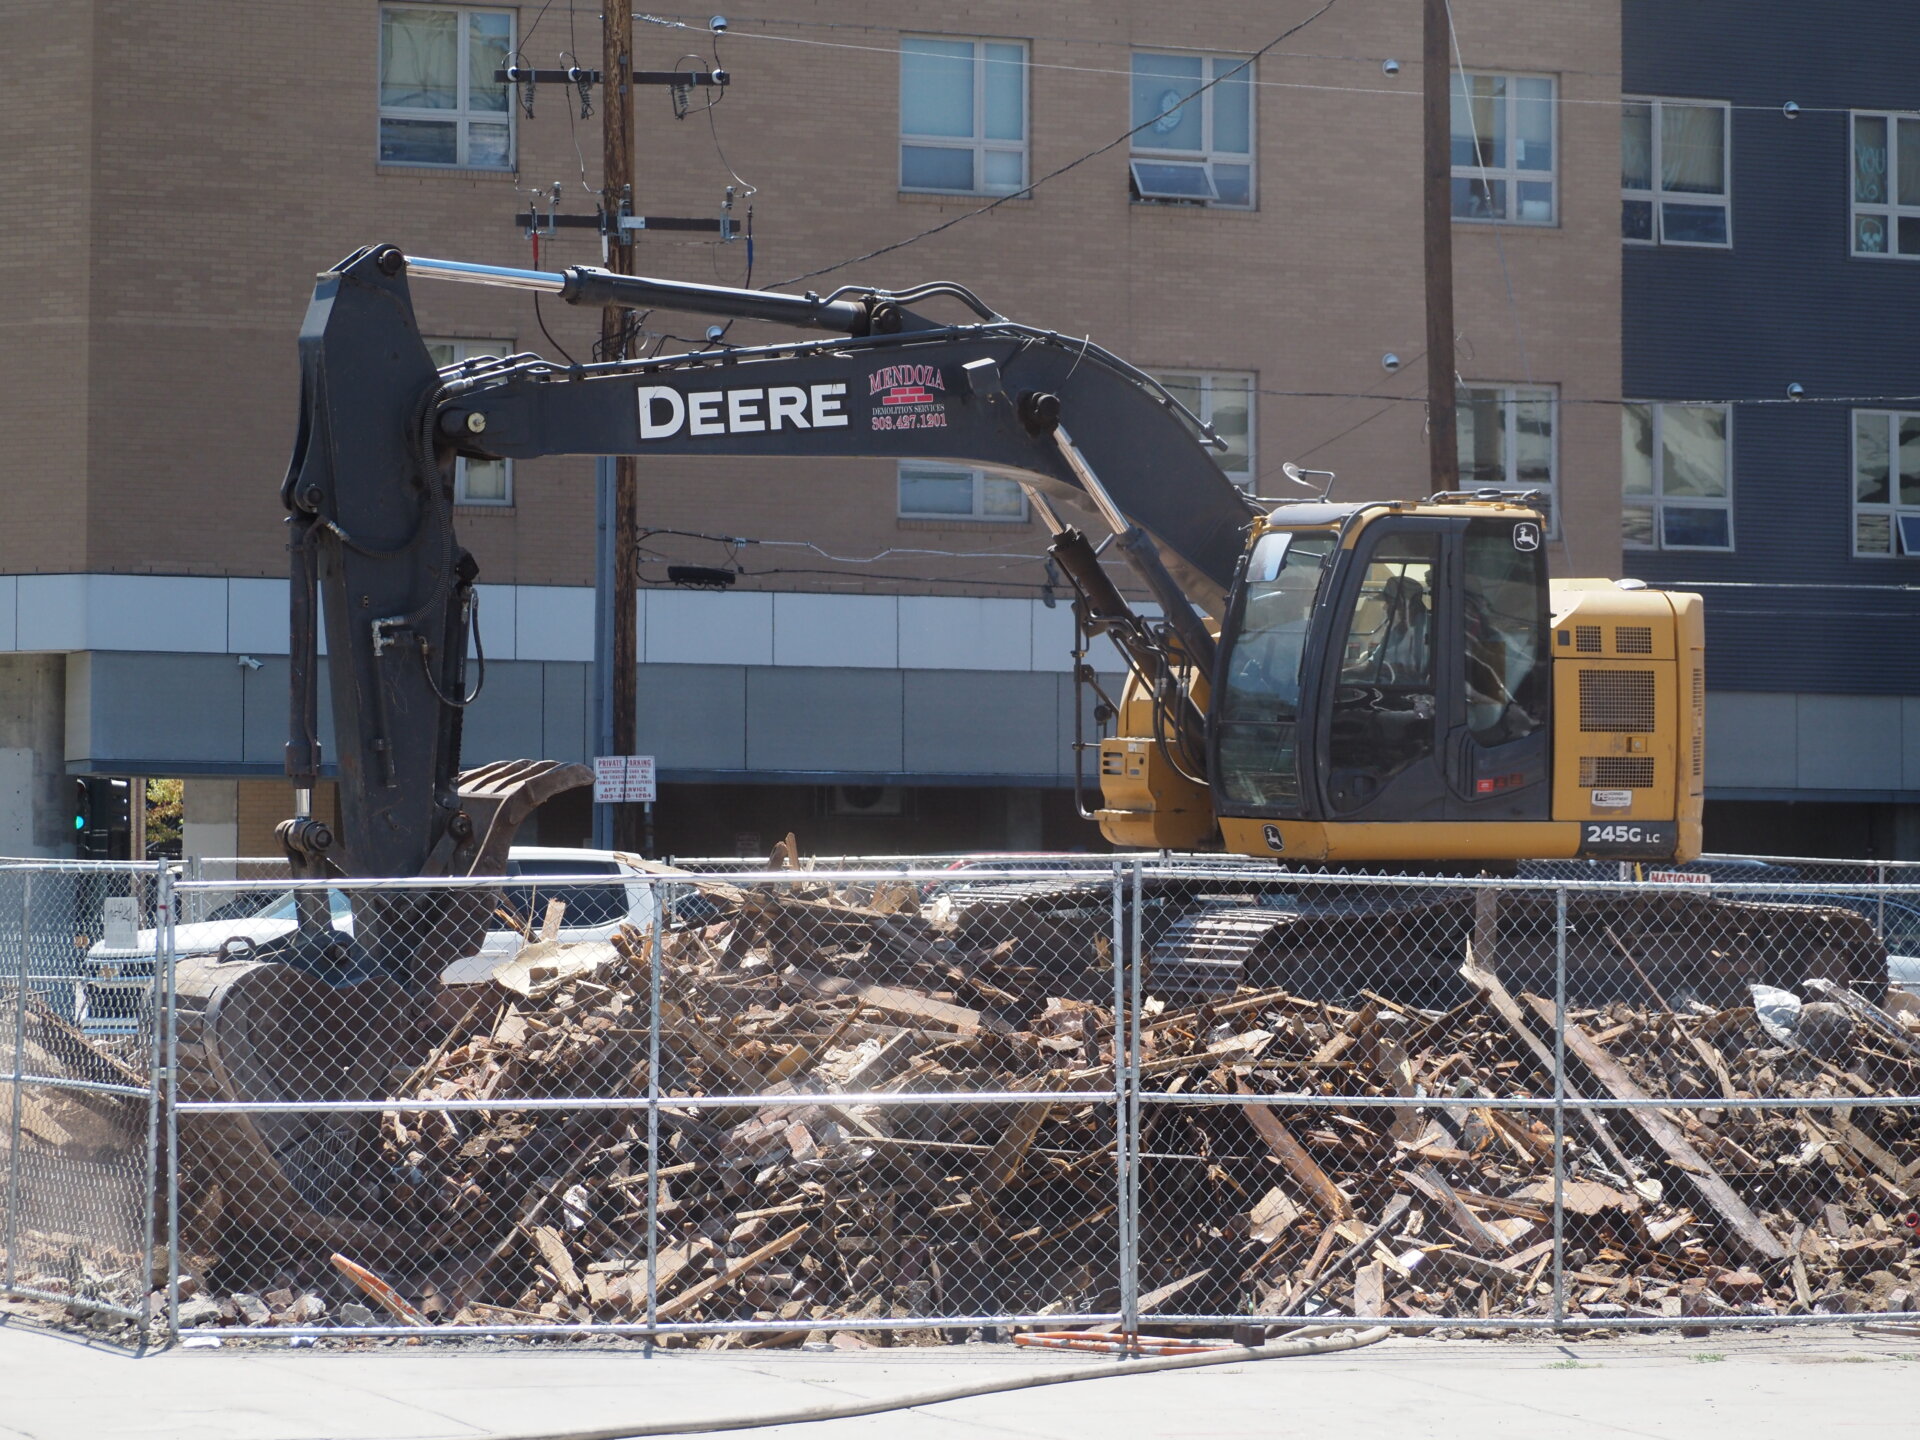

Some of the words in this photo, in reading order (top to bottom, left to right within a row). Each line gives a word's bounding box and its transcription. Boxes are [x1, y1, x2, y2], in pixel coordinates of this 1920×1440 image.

[869, 364, 945, 396] MENDOZA
[637, 383, 849, 439] DEERE
[872, 405, 913, 416] DEMOLITION
[914, 403, 945, 413] SERVICES
[871, 412, 947, 431] 303.427.1201
[598, 759, 622, 768] PRIVATE
[1587, 826, 1641, 843] 245G
[1646, 833, 1660, 843] LC
